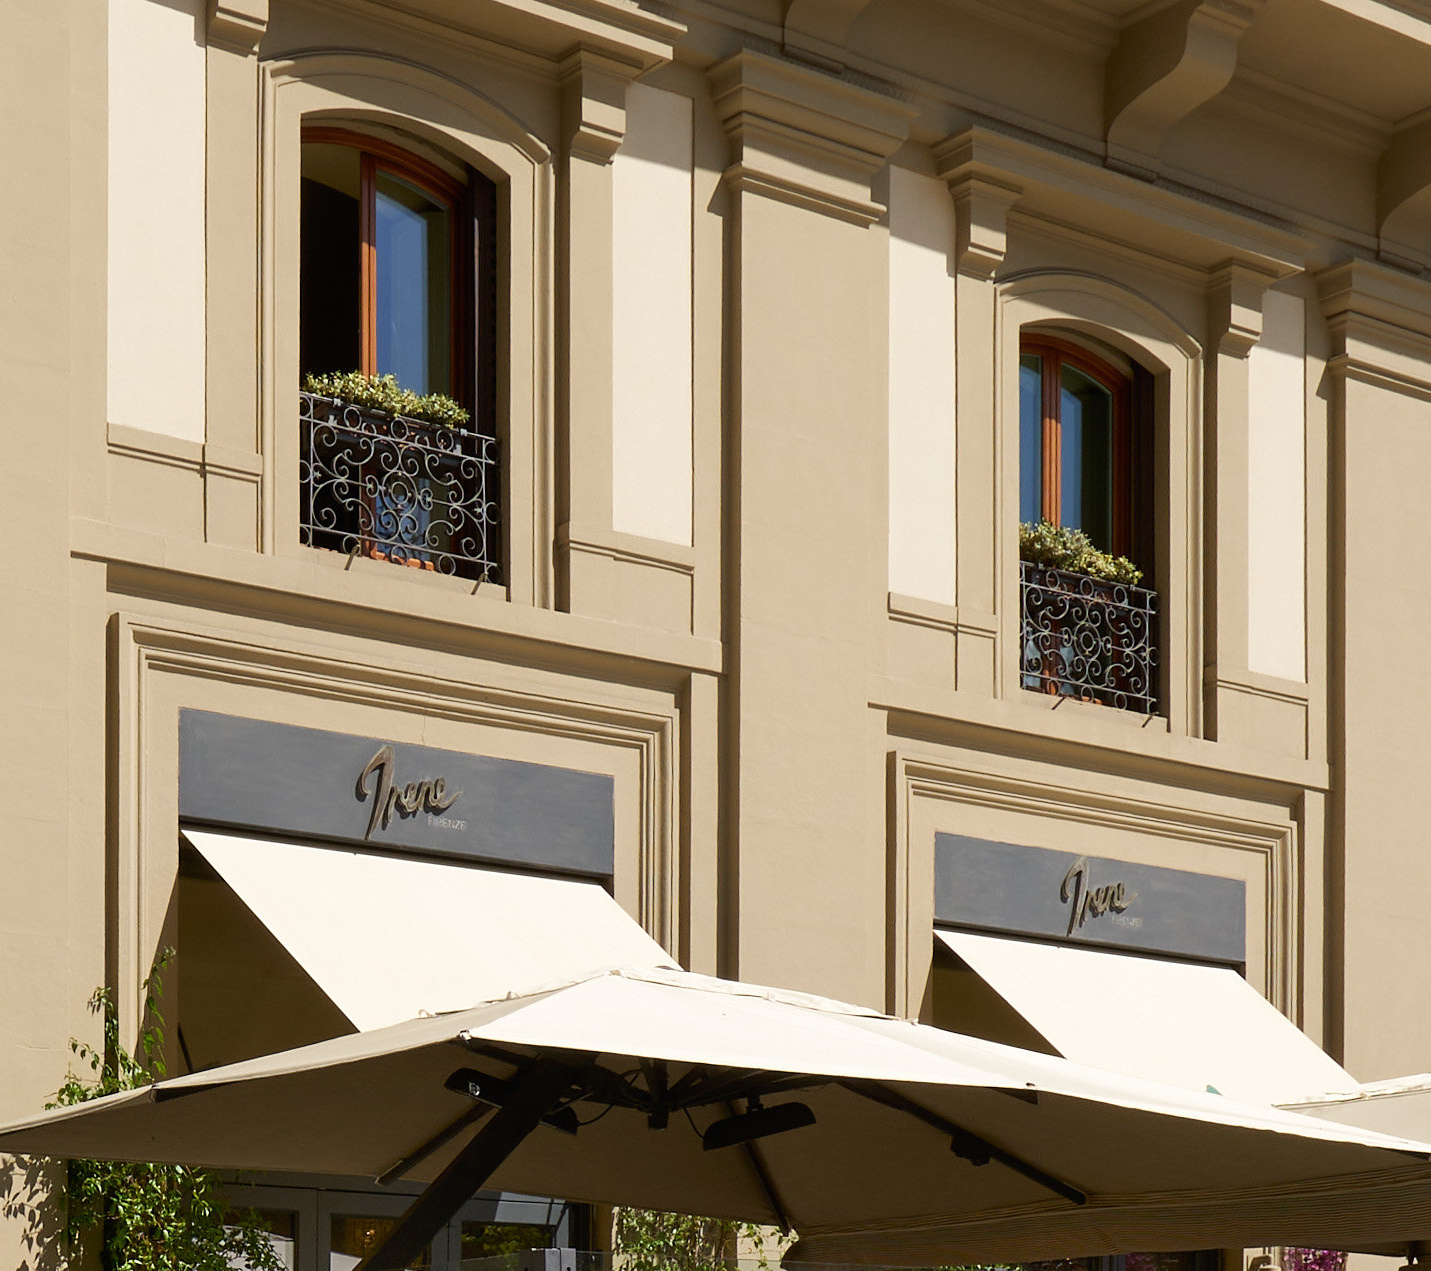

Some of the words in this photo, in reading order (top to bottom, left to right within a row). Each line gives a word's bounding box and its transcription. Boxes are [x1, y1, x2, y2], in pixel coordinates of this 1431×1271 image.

[358, 744, 464, 841] Irene
[427, 815, 468, 832] FIRENZE
[1061, 855, 1139, 938] Irene
